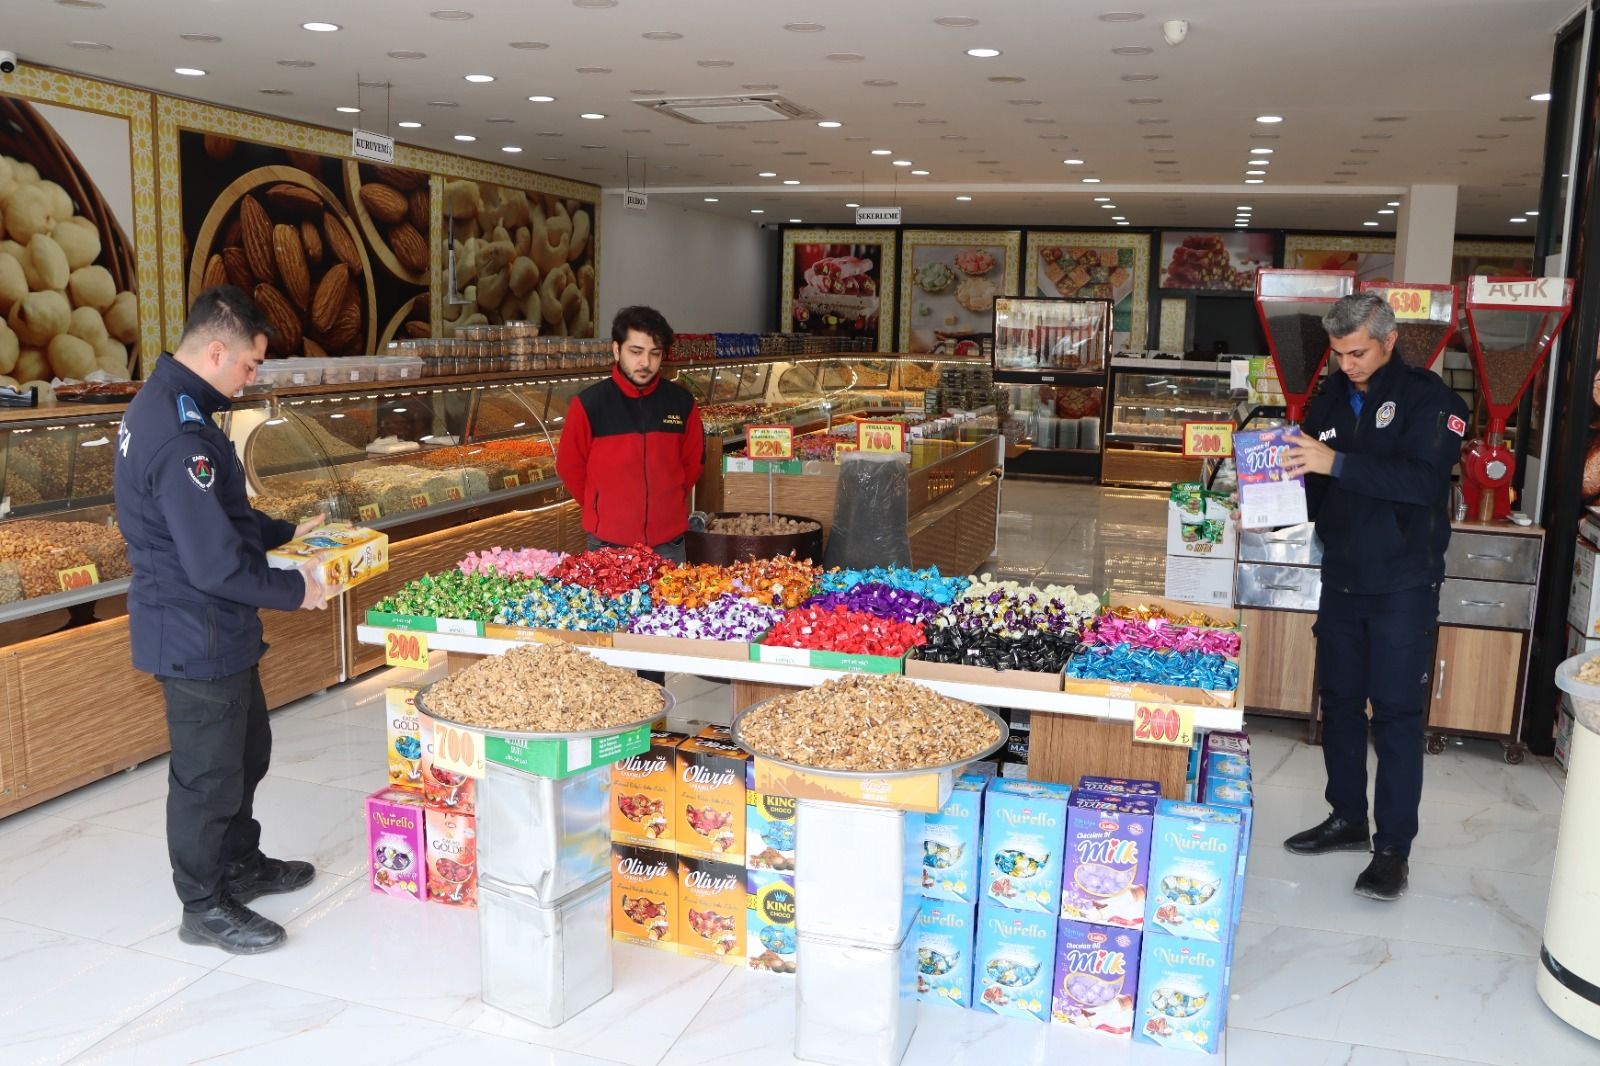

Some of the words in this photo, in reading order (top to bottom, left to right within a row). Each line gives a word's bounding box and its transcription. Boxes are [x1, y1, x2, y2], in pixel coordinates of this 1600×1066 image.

[1388, 291, 1421, 313] 630
[755, 440, 783, 456] 220
[865, 432, 892, 449] 700
[1192, 434, 1221, 452] 200
[387, 633, 420, 661] 200
[393, 719, 420, 731] GOLD
[1135, 706, 1181, 742] 200
[435, 724, 475, 767] 700
[682, 765, 736, 788] Olivya
[766, 796, 796, 808] KING
[770, 806, 792, 814] CHOCO
[943, 804, 969, 818] ello
[372, 811, 415, 830] Nurello
[996, 807, 1057, 827] Nurello
[432, 840, 474, 855] GOLDEN
[1077, 838, 1139, 865] Milk
[1164, 831, 1228, 853] Nurello
[617, 857, 669, 880] Olivya
[684, 871, 737, 894] Olivya
[766, 900, 796, 913] KING
[770, 910, 791, 919] CHOCO
[988, 919, 1048, 938] Nurello
[1067, 950, 1127, 975] Milk
[1153, 945, 1217, 968] Nurello
